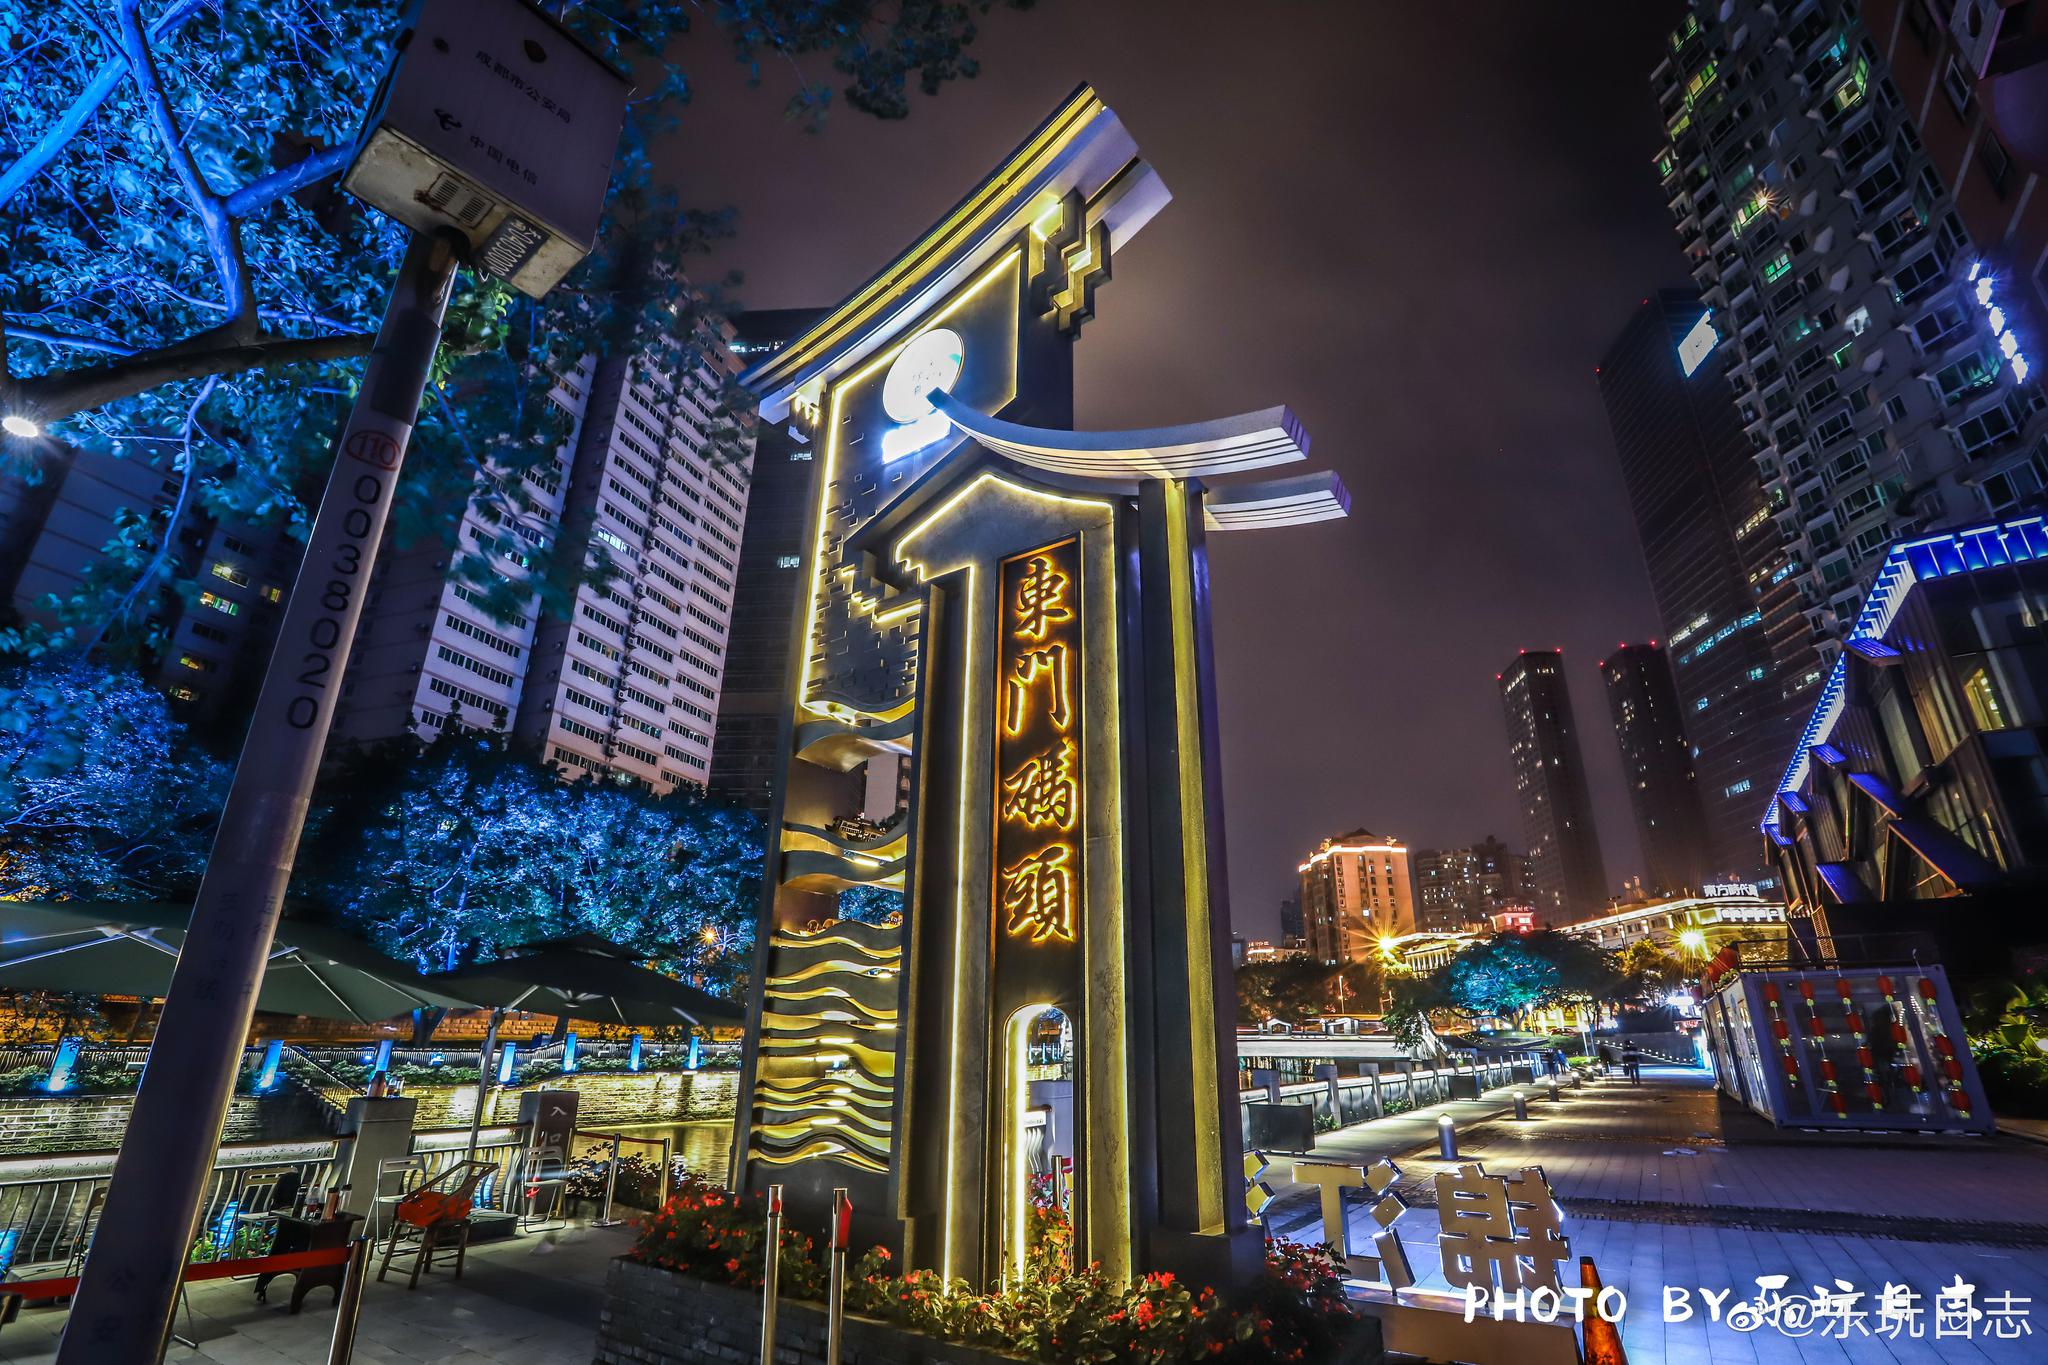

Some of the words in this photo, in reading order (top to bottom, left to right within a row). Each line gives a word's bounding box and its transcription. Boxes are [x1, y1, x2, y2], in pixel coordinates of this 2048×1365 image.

[475, 50, 571, 124] 成都市公安局
[470, 135, 538, 185] 中国电信
[357, 433, 399, 459] 110
[287, 475, 381, 730] 0038020
[1003, 557, 1076, 943] 東門碼頭
[550, 1106, 568, 1143] 入口
